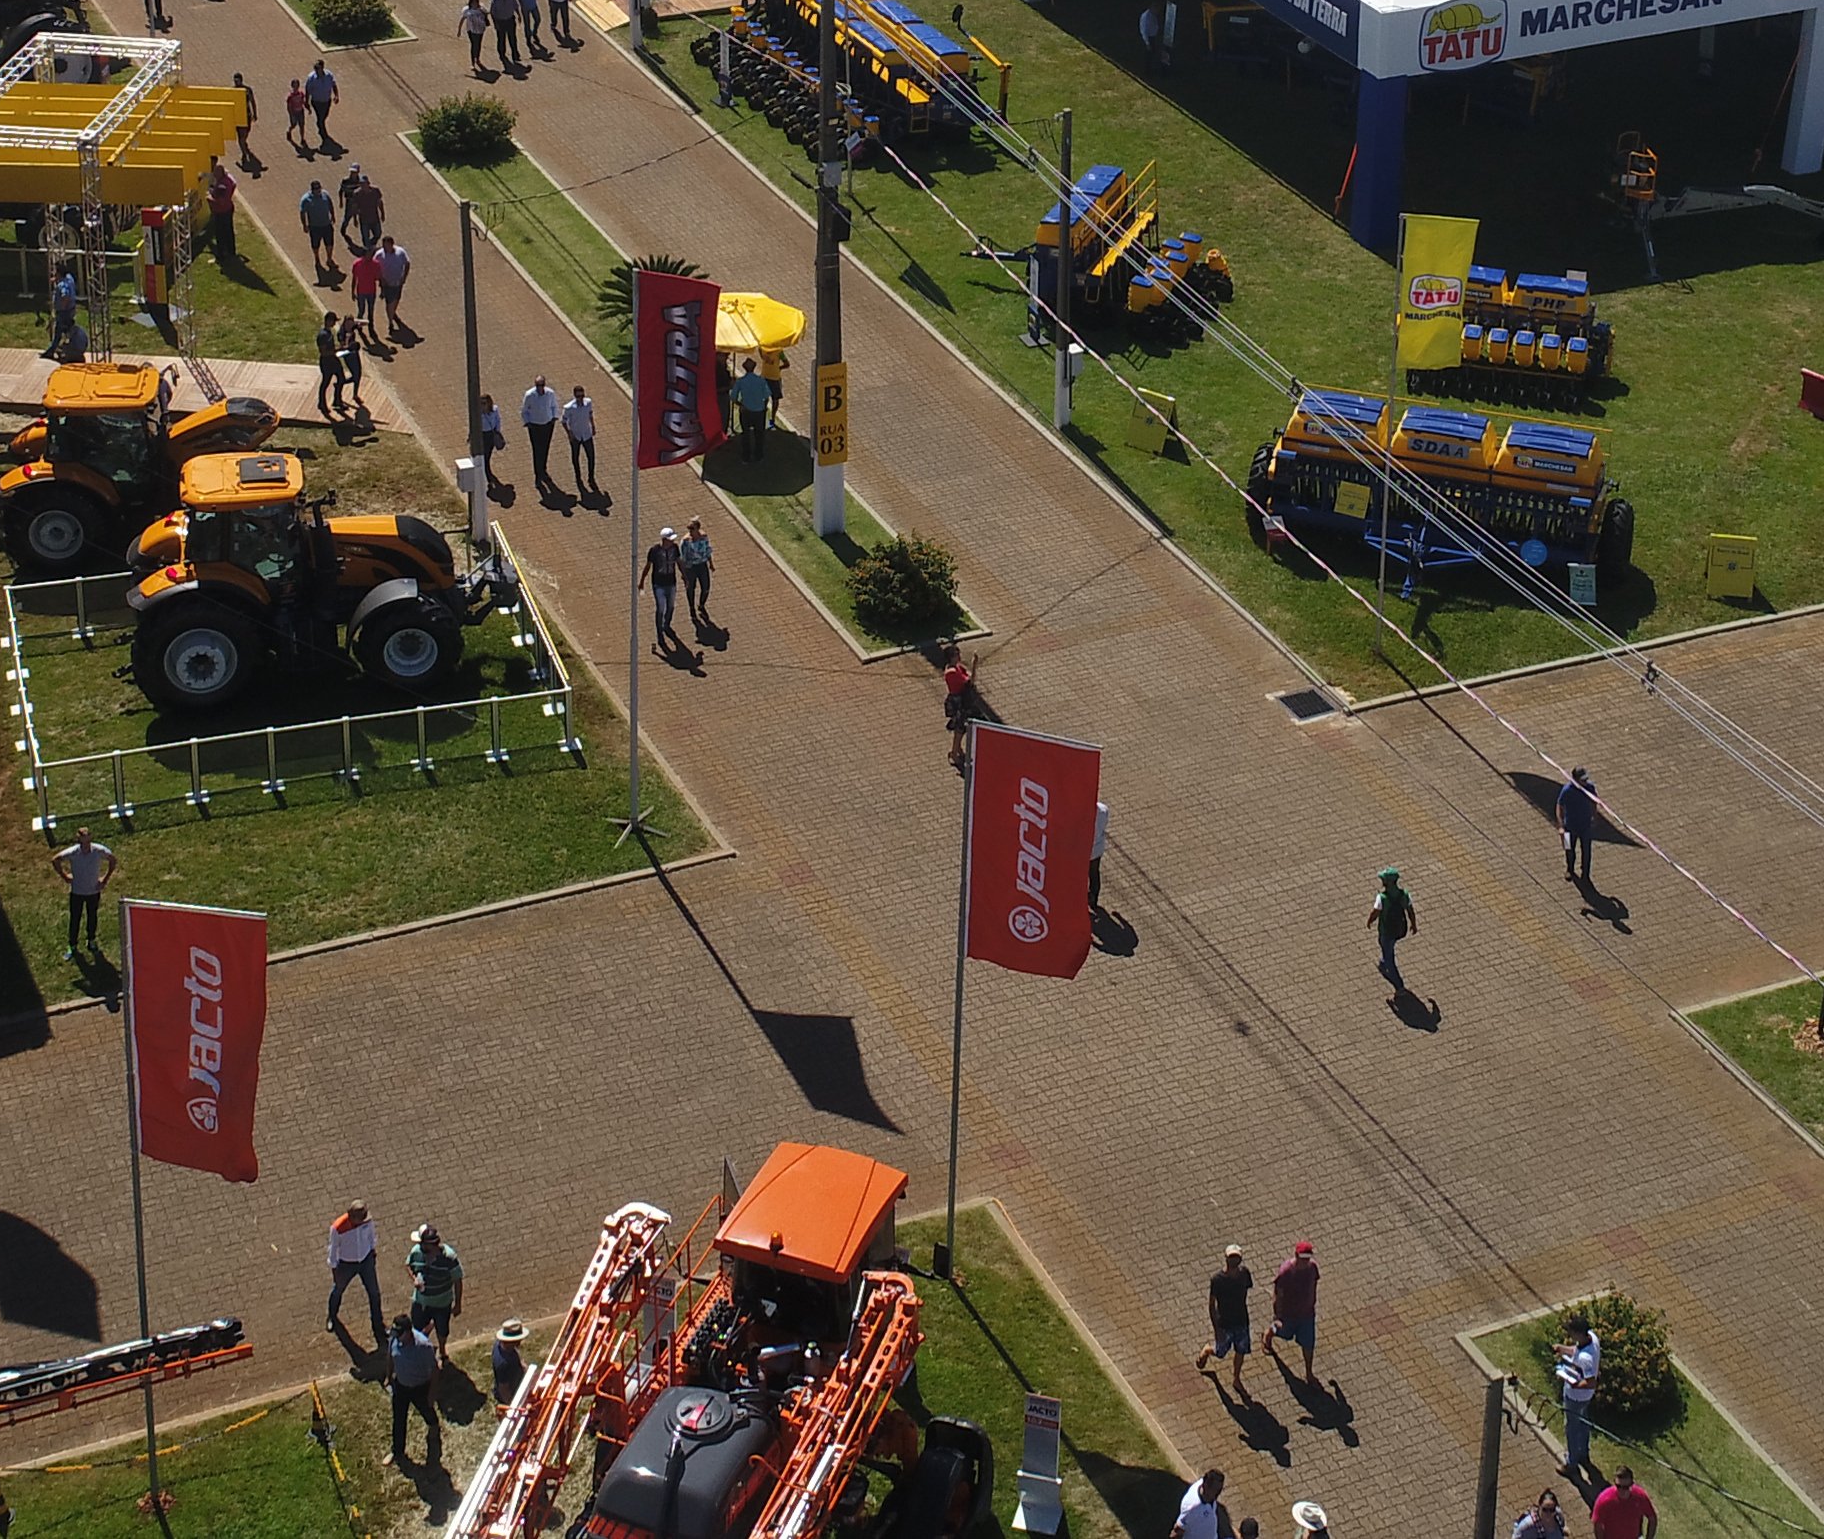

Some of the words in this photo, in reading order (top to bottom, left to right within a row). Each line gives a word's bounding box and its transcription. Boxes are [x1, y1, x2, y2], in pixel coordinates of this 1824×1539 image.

[1422, 26, 1503, 66] TATU
[1412, 290, 1460, 305] TATU
[1533, 295, 1566, 308] PHP
[659, 300, 702, 465] VALTRA
[824, 384, 843, 413] B
[820, 424, 845, 437] RUA
[820, 435, 845, 456] 03
[1409, 437, 1452, 457] SDA
[1454, 445, 1467, 459] A
[1534, 462, 1575, 474] MARCHESAN
[1028, 1405, 1058, 1418] JACTO
